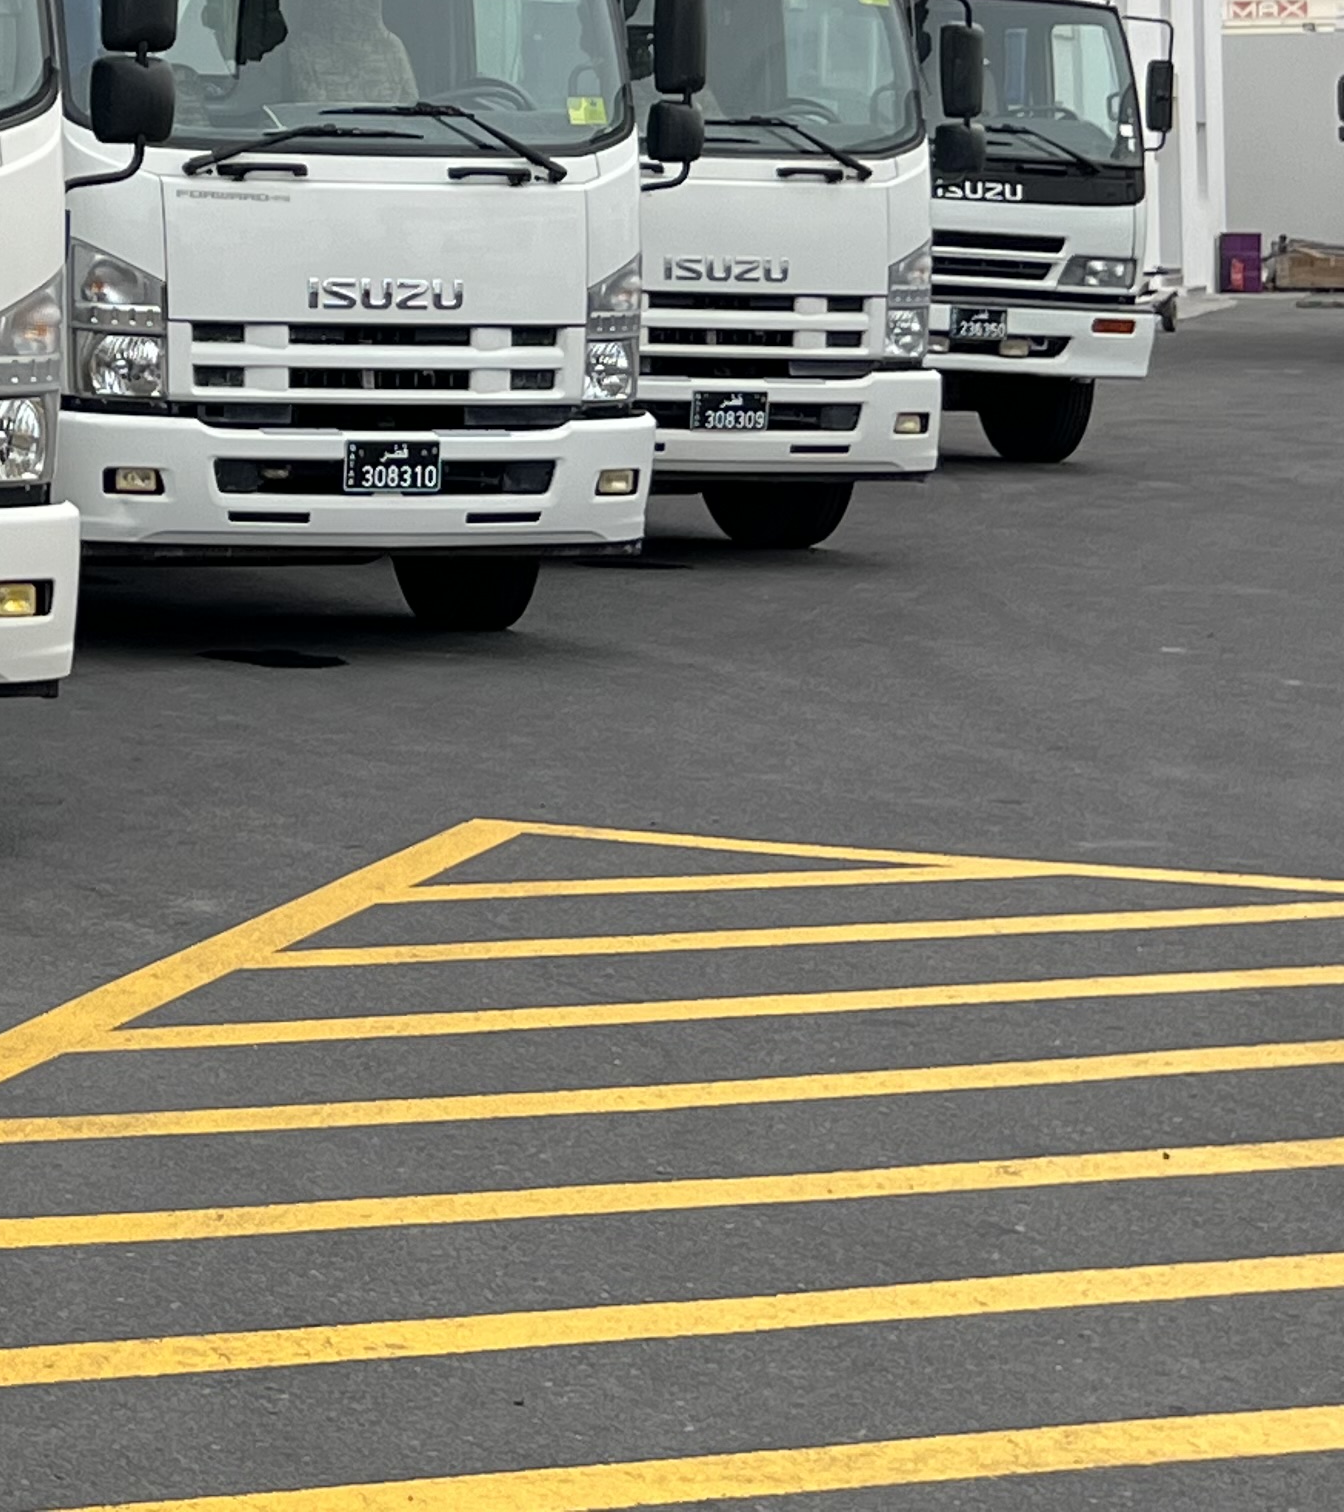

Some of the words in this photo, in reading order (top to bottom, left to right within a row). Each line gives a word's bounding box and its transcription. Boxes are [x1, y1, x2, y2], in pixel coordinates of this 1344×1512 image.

[1229, 0, 1308, 20] MAX
[663, 254, 789, 282] ISUZU
[308, 276, 464, 310] ISUZU
[704, 410, 765, 428] 308309
[379, 443, 409, 463] قطر
[361, 464, 437, 487] 308310
